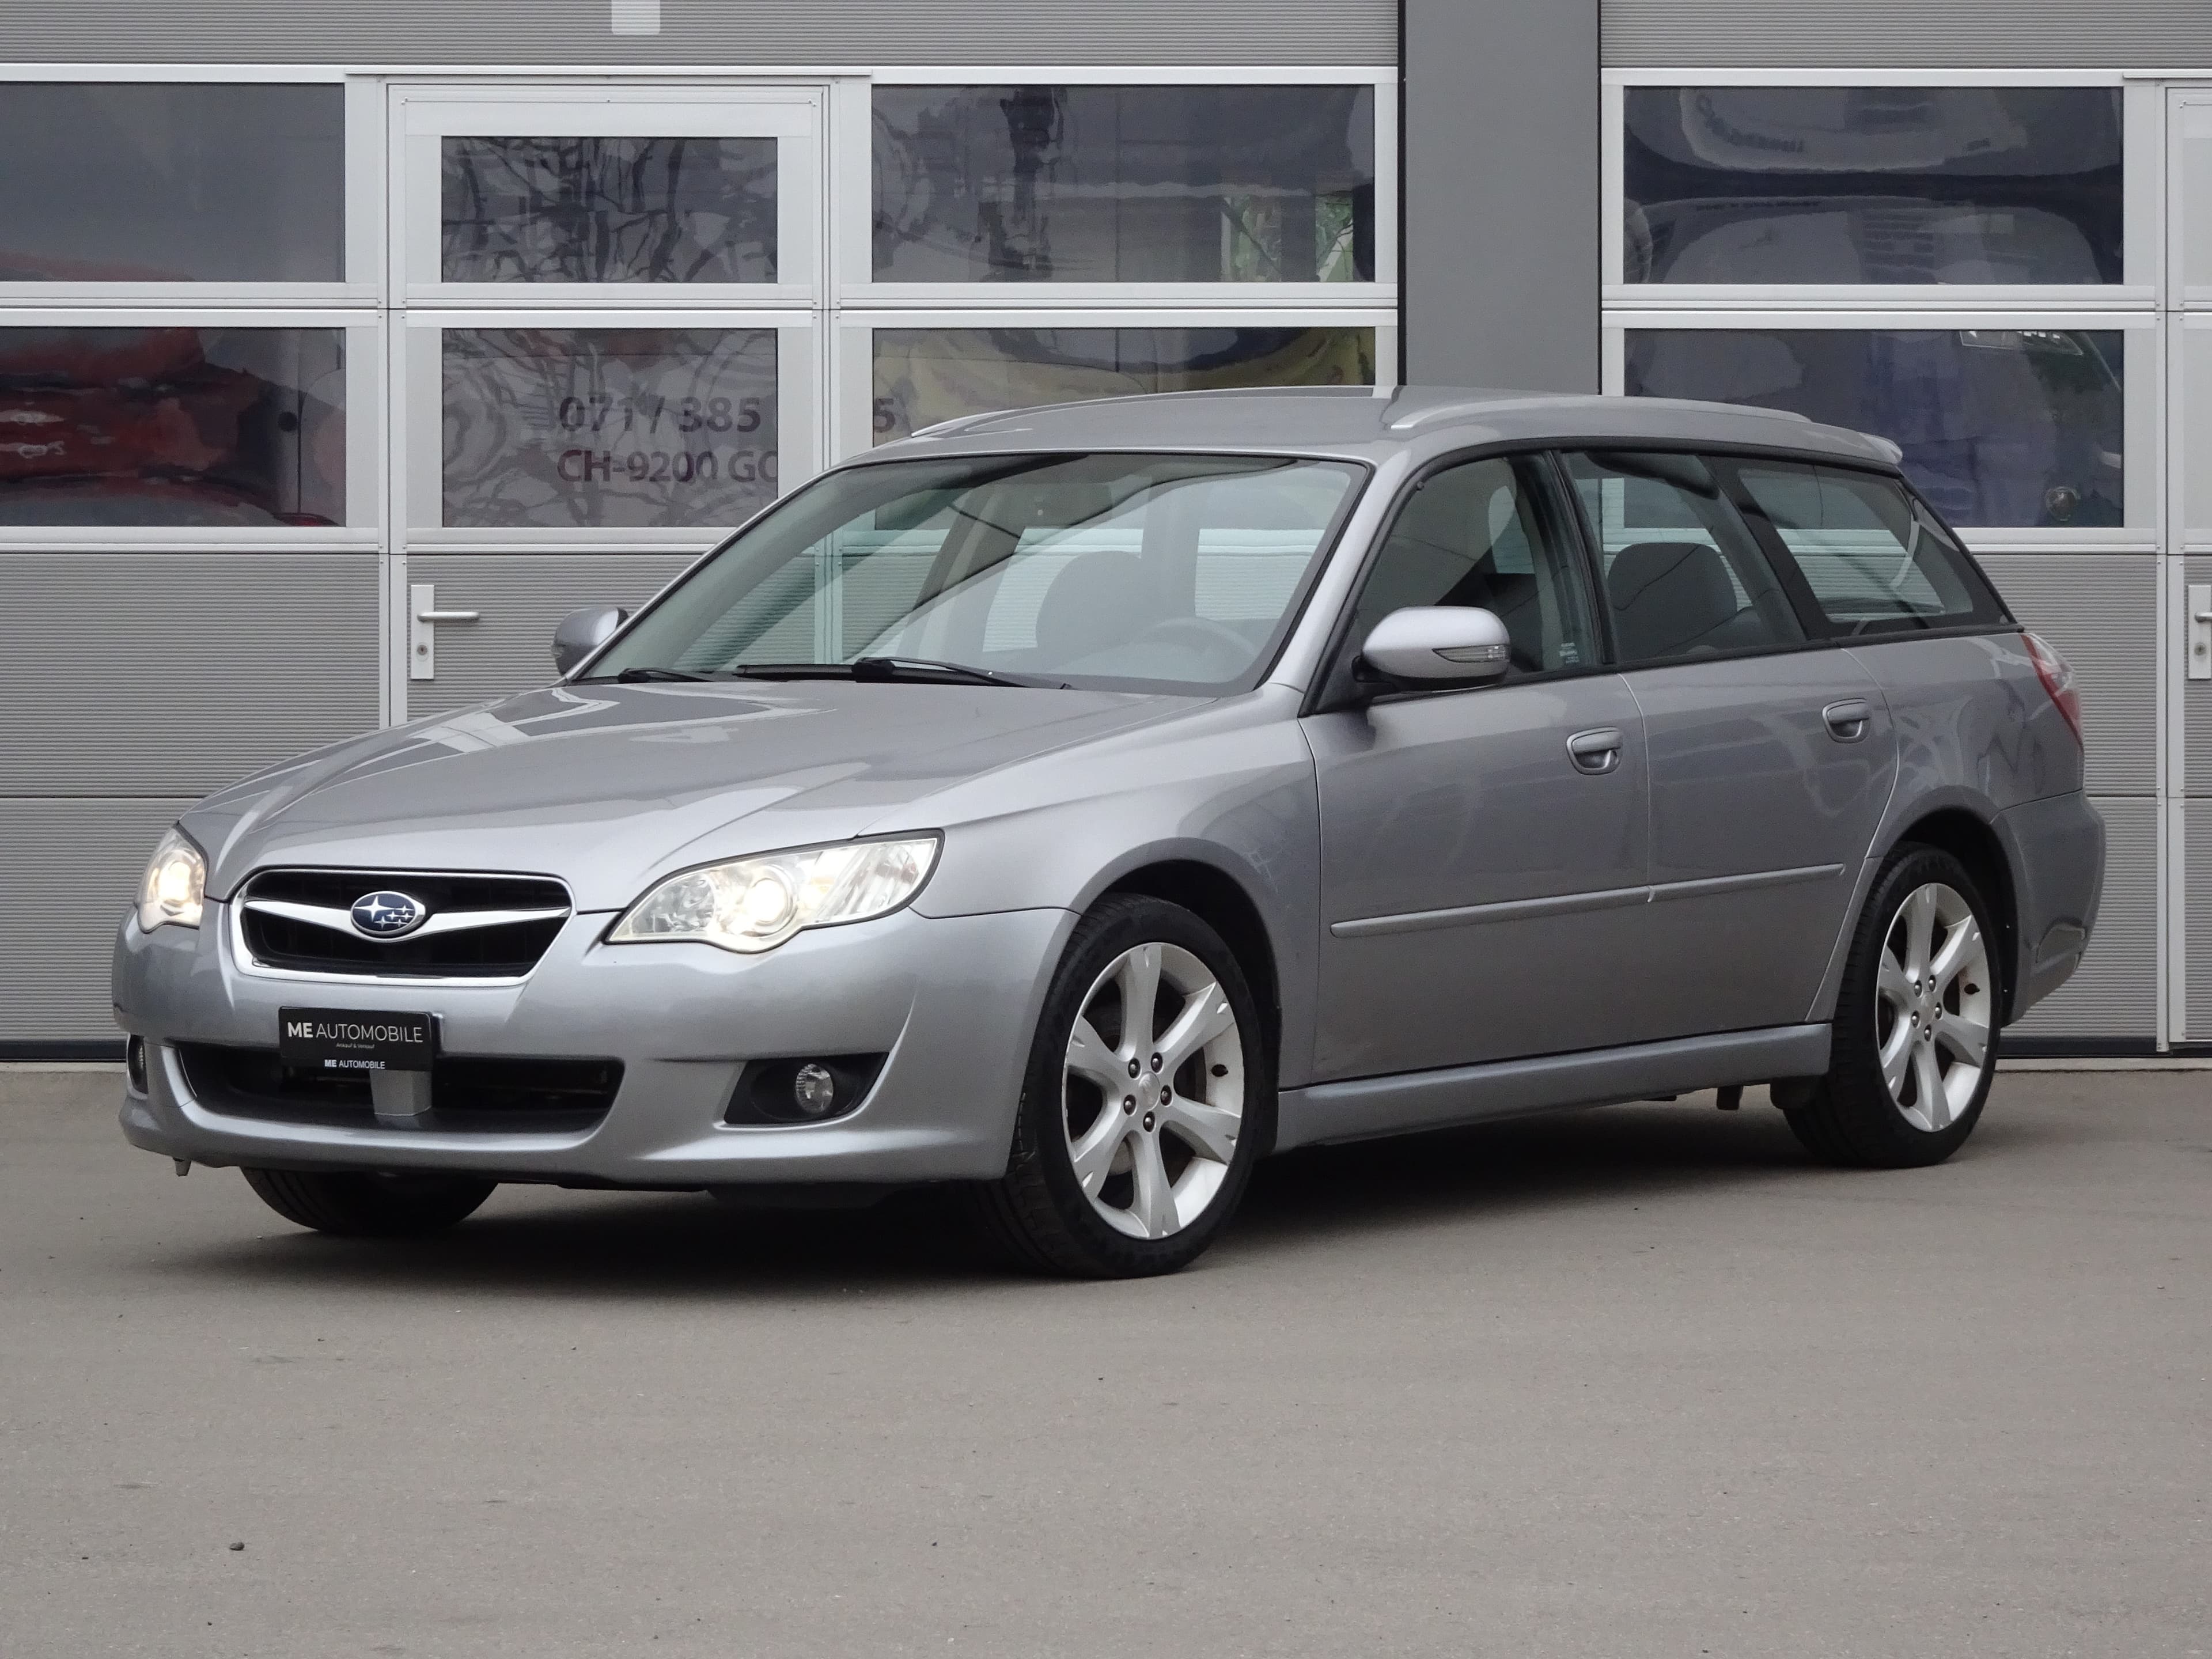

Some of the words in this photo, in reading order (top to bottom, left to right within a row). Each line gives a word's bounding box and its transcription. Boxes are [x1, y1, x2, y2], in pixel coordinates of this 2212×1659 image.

[678, 396, 760, 432] 385
[557, 449, 718, 482] CH-9200
[287, 1021, 313, 1037] ME
[316, 1023, 423, 1043] AUTOMOBILE
[324, 1059, 337, 1067] ME
[339, 1060, 385, 1069] AUTOMOBILE
